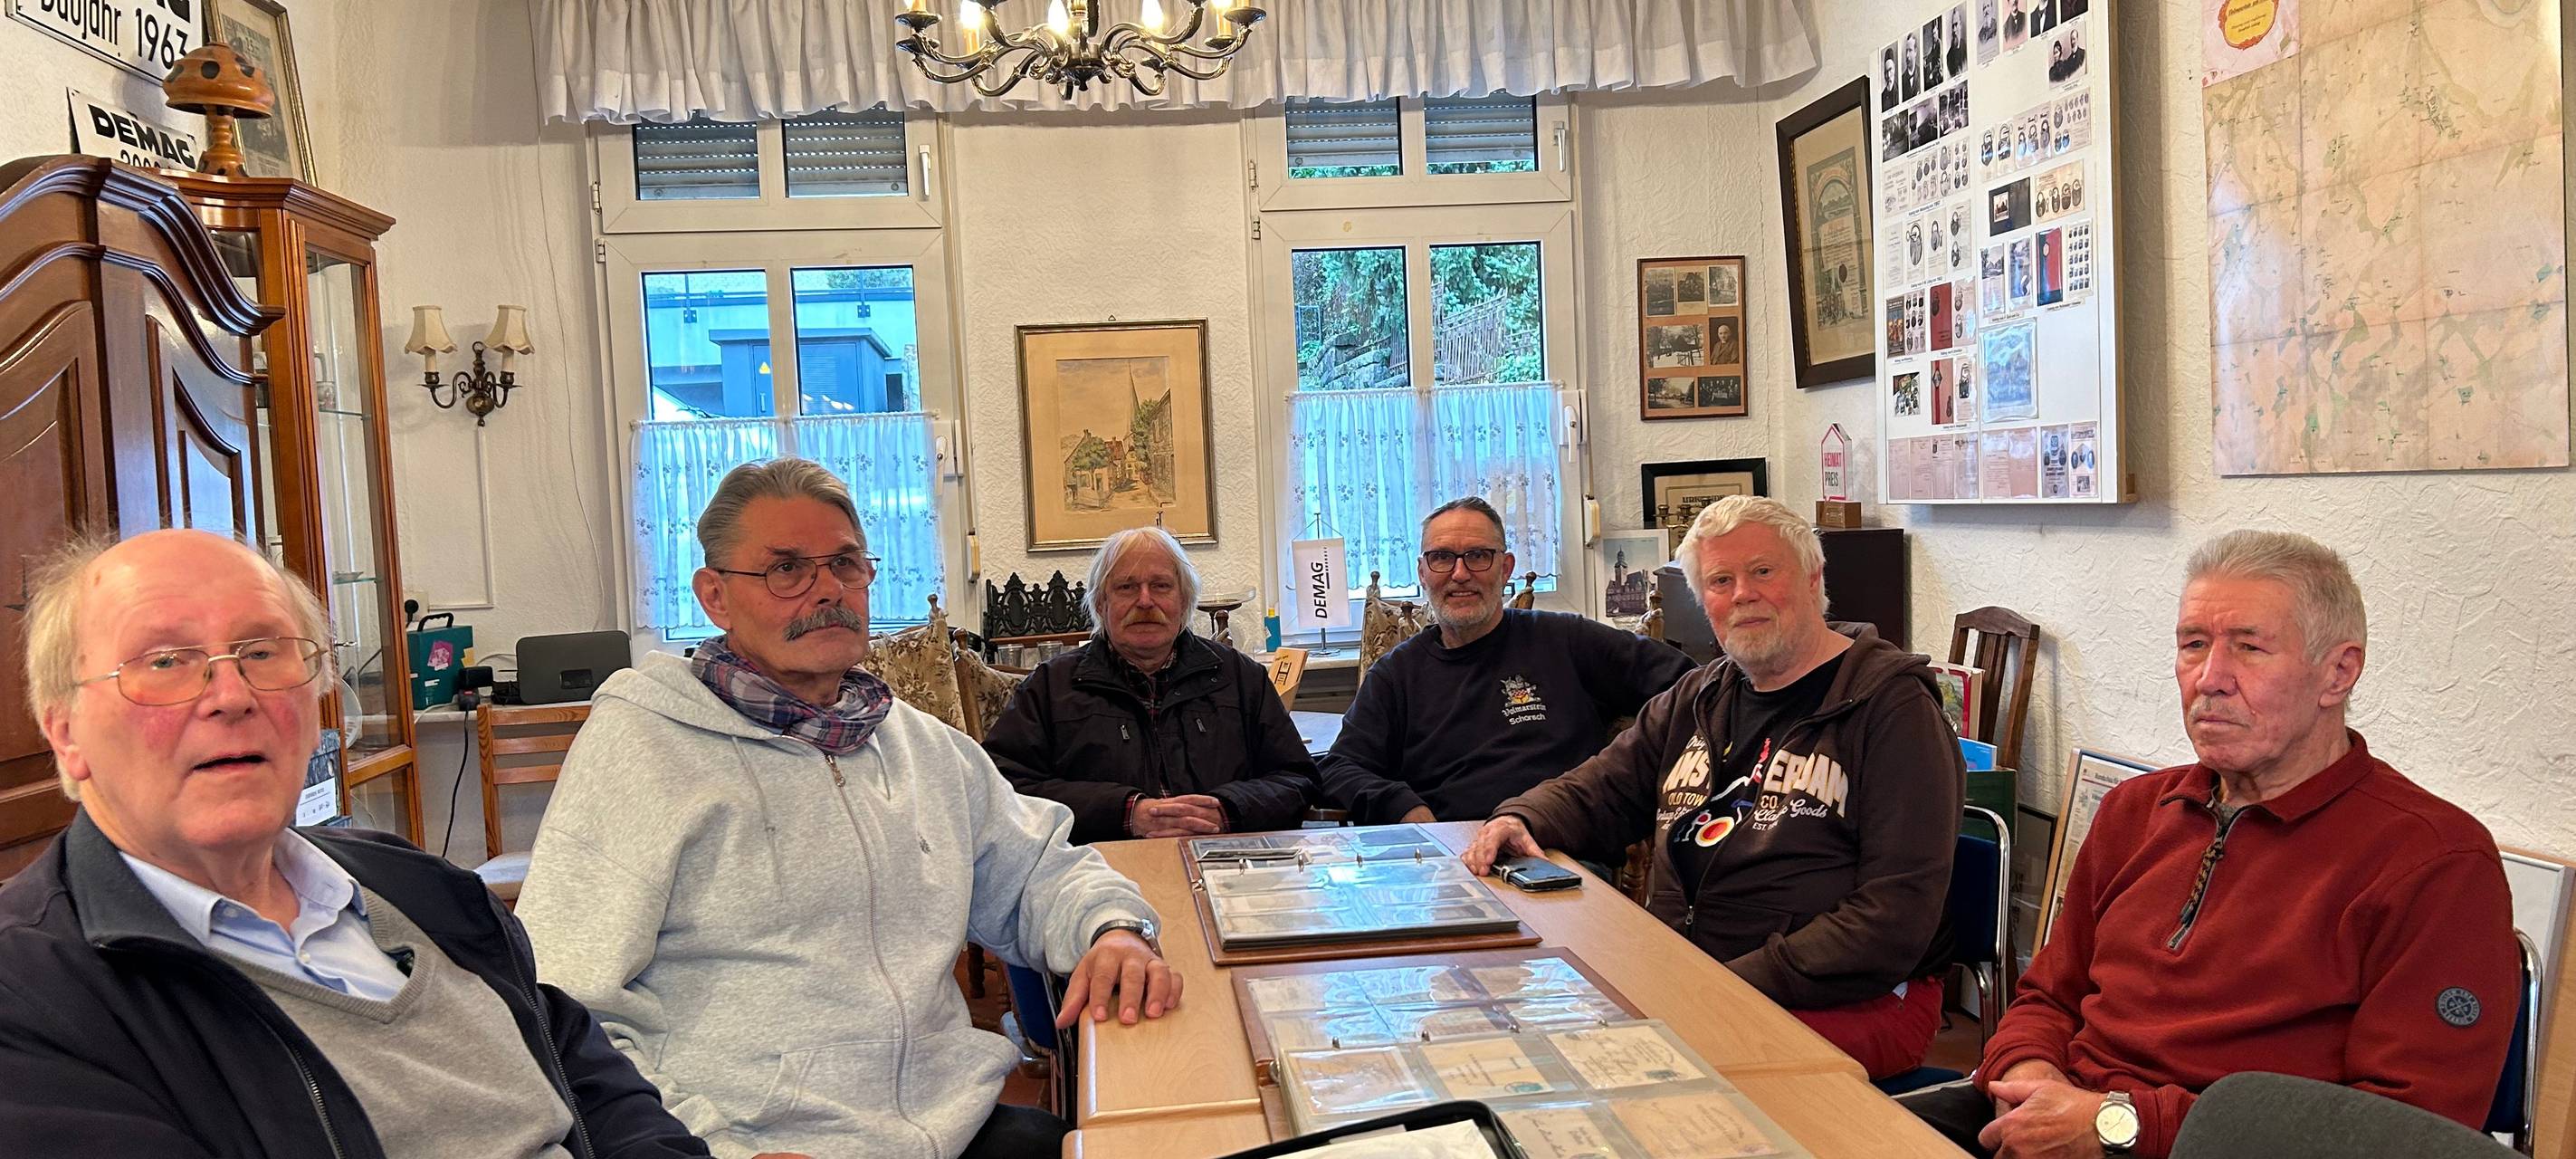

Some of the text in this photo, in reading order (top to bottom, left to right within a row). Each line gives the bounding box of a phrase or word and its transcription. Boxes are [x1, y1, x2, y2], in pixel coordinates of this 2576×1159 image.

[136, 8, 187, 70] 1963
[88, 104, 196, 169] DEMAG
[1825, 472, 1839, 486] PREIS
[1311, 561, 1328, 618] DEMAG
[1790, 799, 1827, 818] Goods
